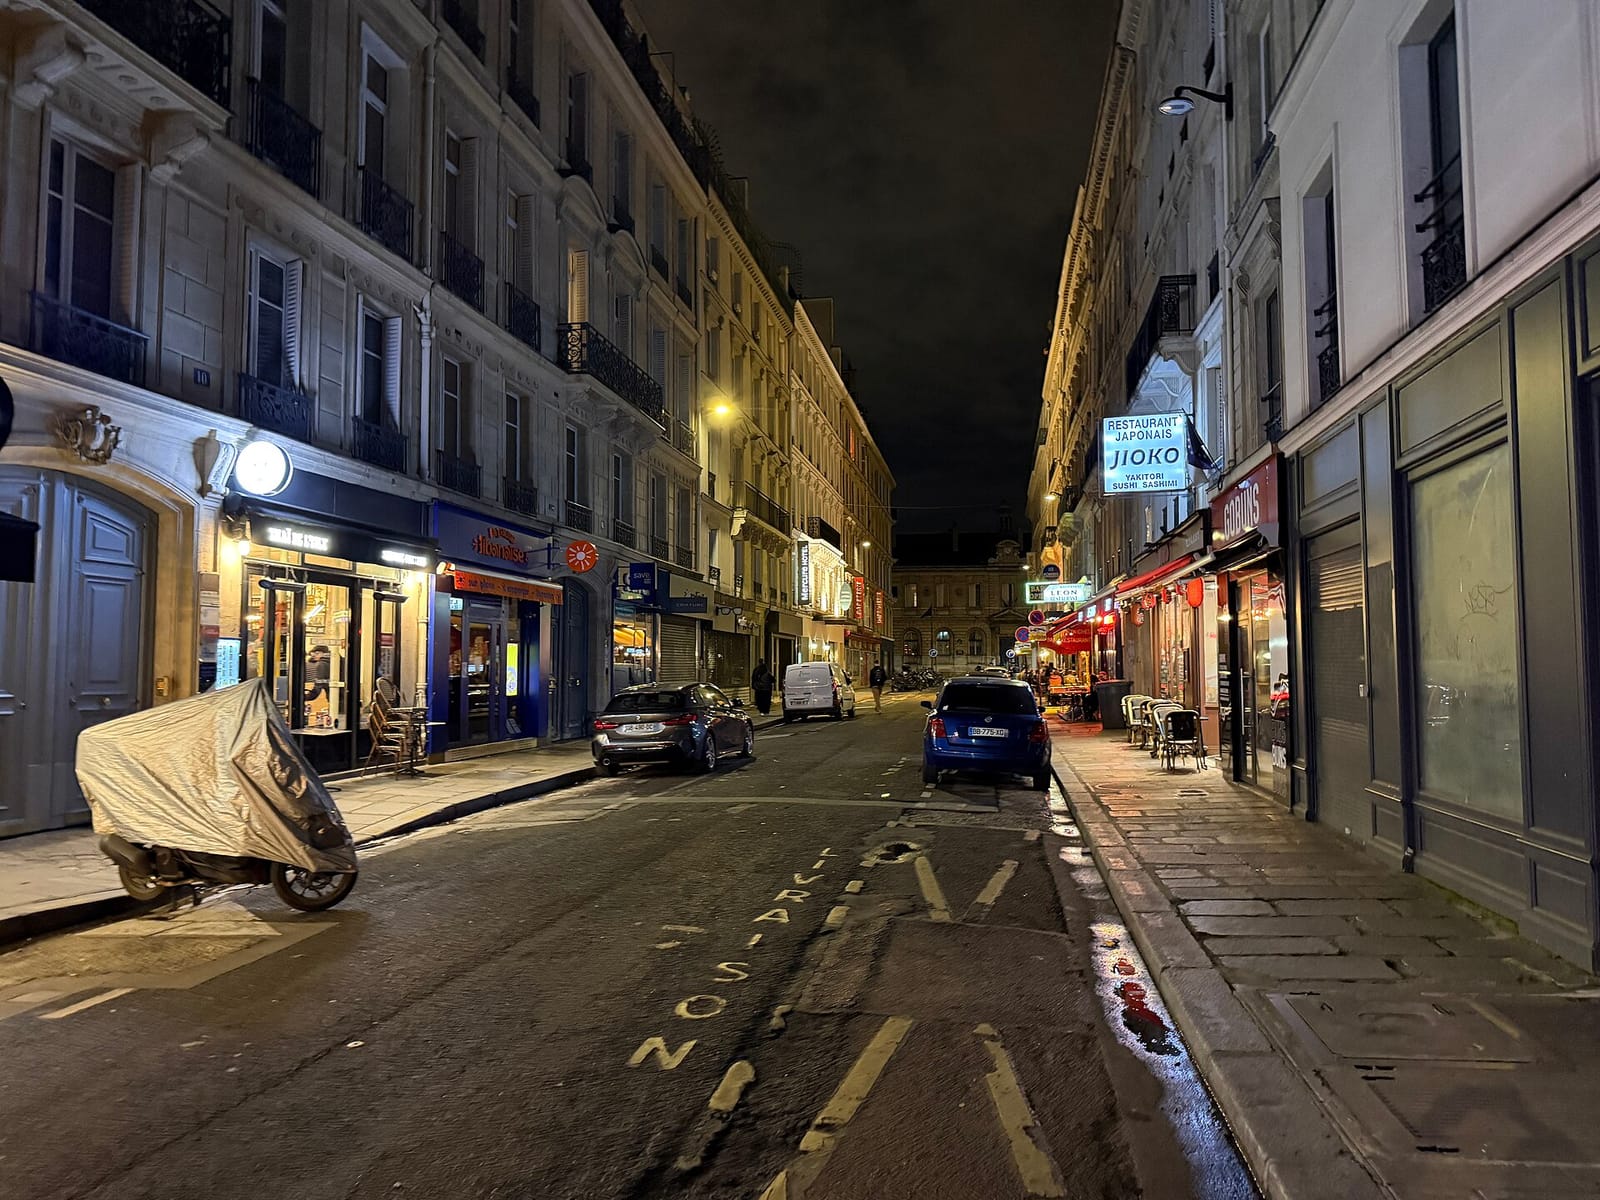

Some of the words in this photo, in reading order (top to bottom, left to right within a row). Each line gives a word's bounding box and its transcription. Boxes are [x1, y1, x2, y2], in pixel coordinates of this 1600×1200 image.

[197, 370, 207, 385] 10
[1108, 416, 1178, 431] RESTAURANT
[1115, 429, 1173, 442] JAPONAIS
[1109, 447, 1179, 470] JIOKO
[1125, 472, 1164, 482] YAKITORI
[1112, 482, 1138, 490] SUSHI
[1142, 480, 1178, 489] SASHIMI
[1223, 484, 1261, 541] GOBUNS
